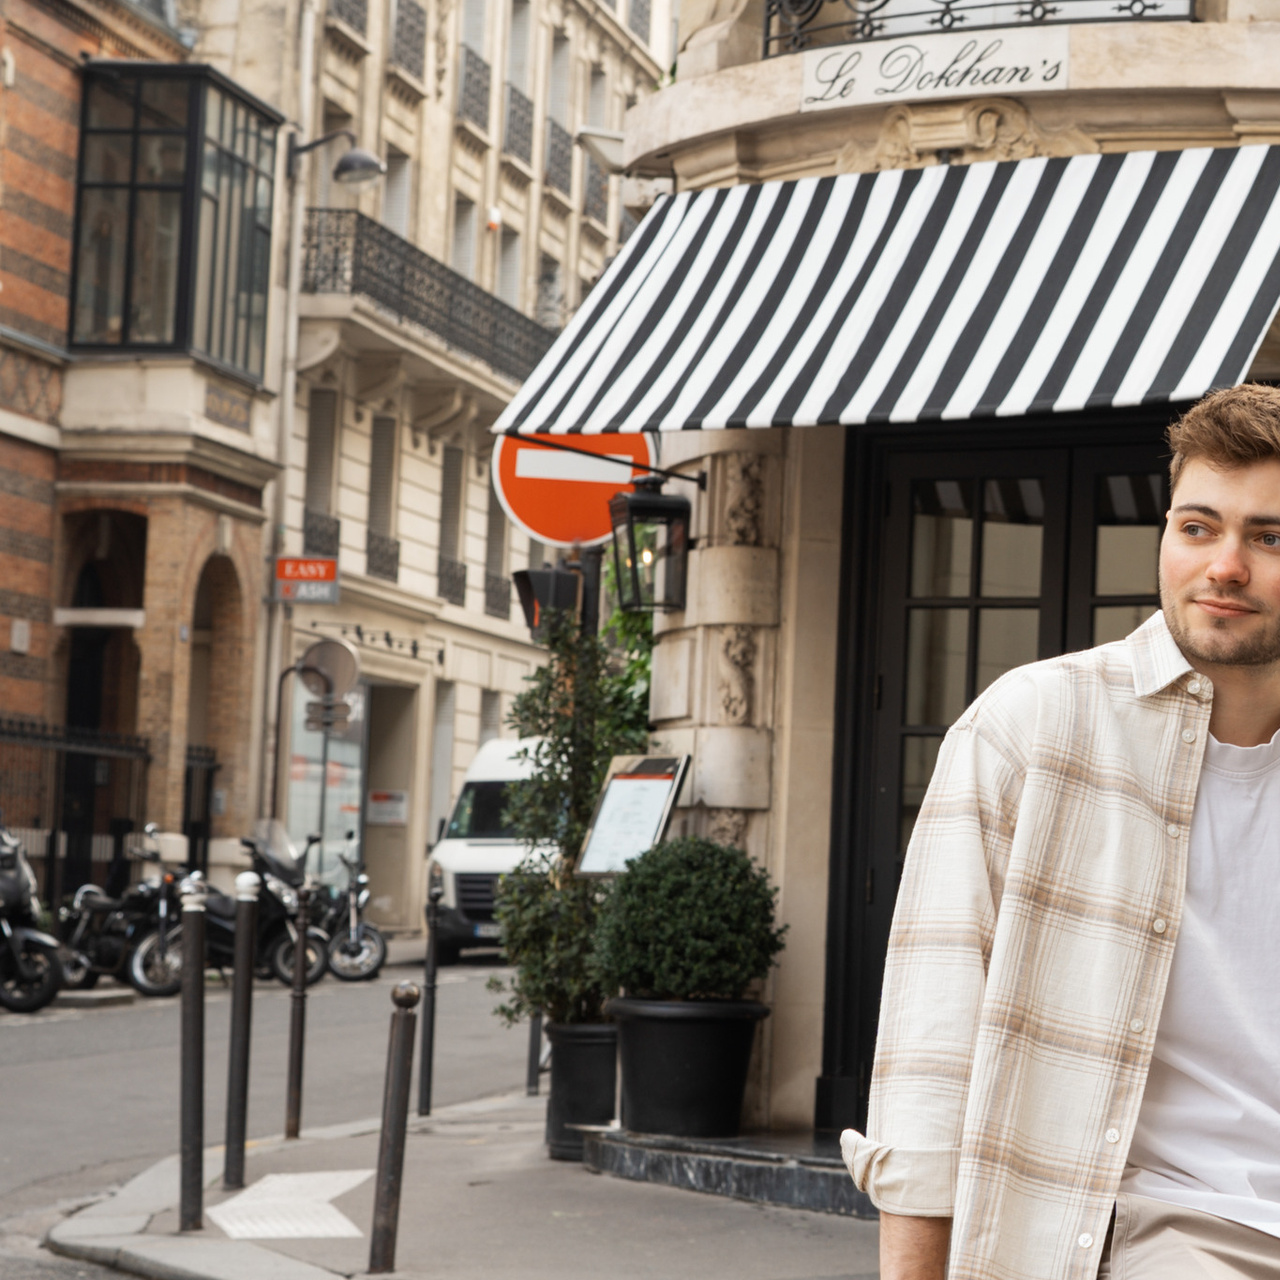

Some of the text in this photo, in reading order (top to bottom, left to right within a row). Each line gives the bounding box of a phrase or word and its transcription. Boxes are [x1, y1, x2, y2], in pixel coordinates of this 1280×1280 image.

[804, 39, 1063, 104] Le Dokhan's
[284, 561, 328, 578] EASY
